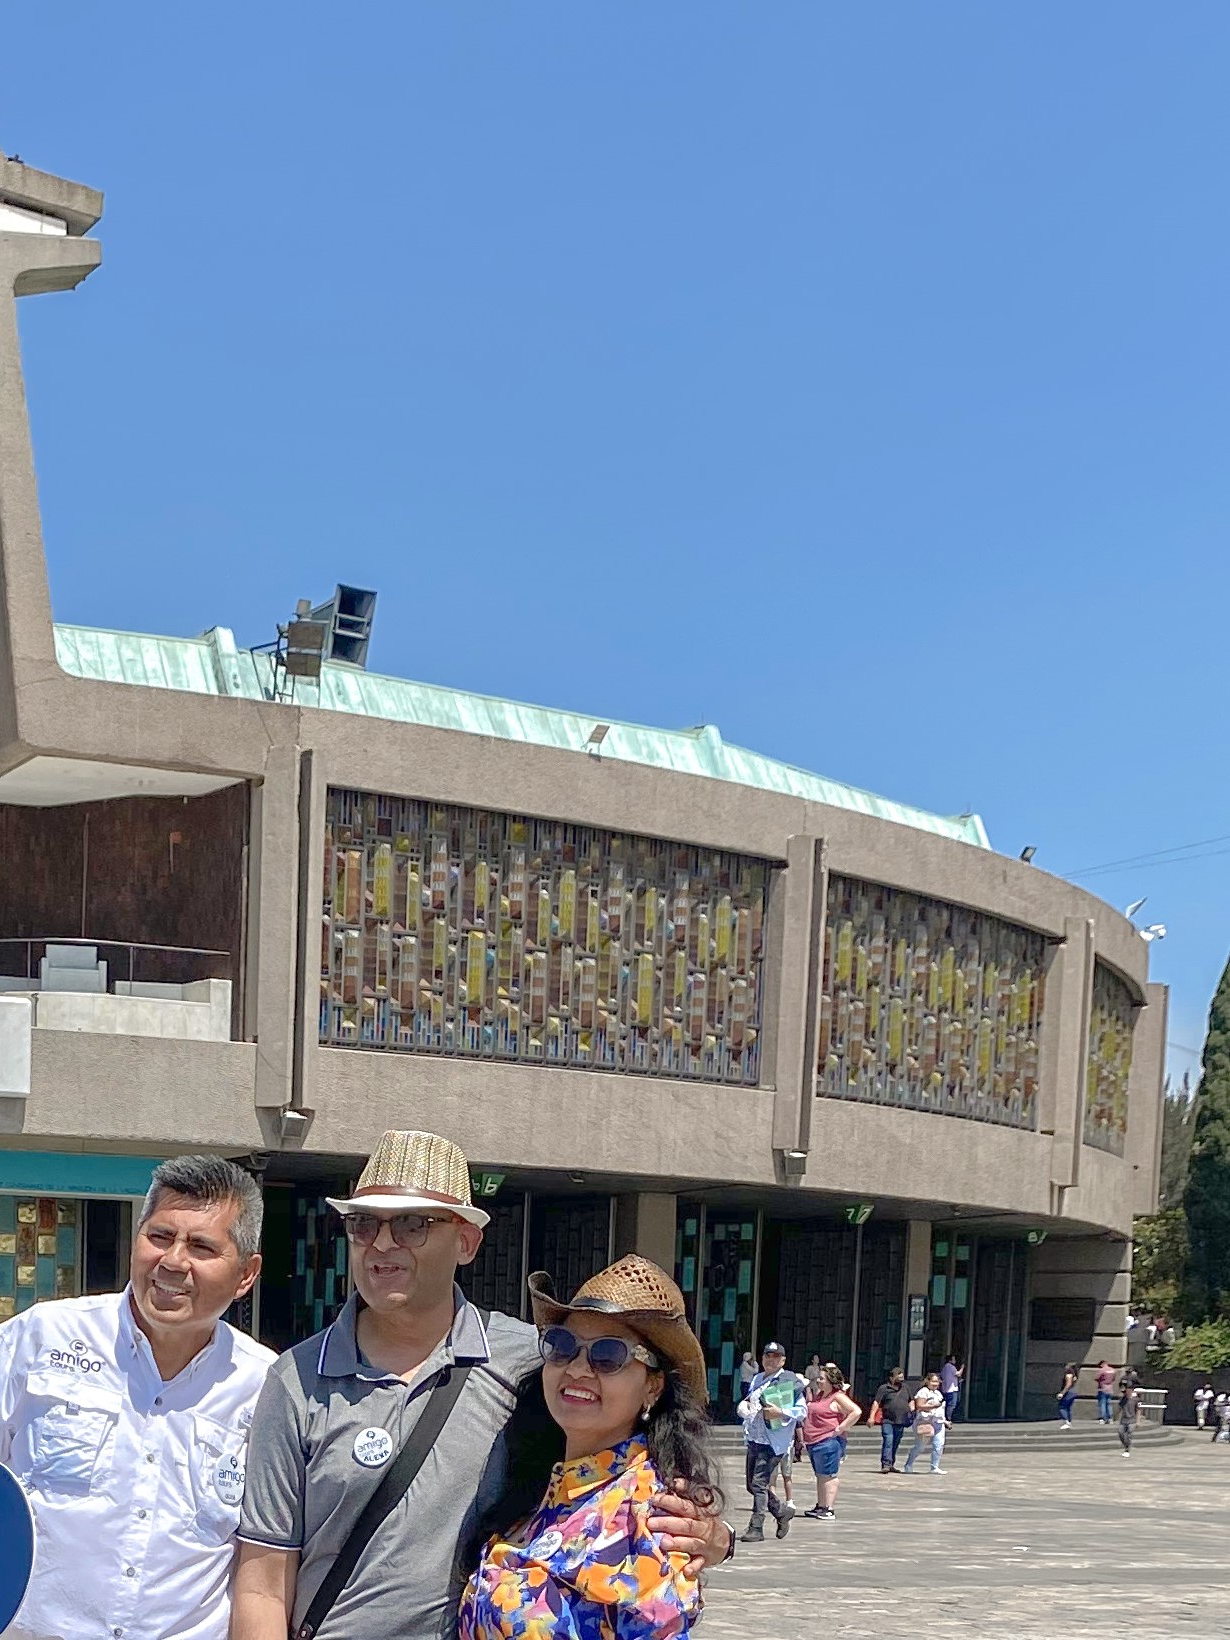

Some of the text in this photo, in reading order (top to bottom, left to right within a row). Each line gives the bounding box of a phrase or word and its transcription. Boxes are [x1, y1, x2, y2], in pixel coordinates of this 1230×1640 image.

[846, 1208, 855, 1219] 7
[50, 1349, 101, 1373] amigo
[357, 1437, 388, 1453] amigo
[219, 1469, 245, 1485] amigo
